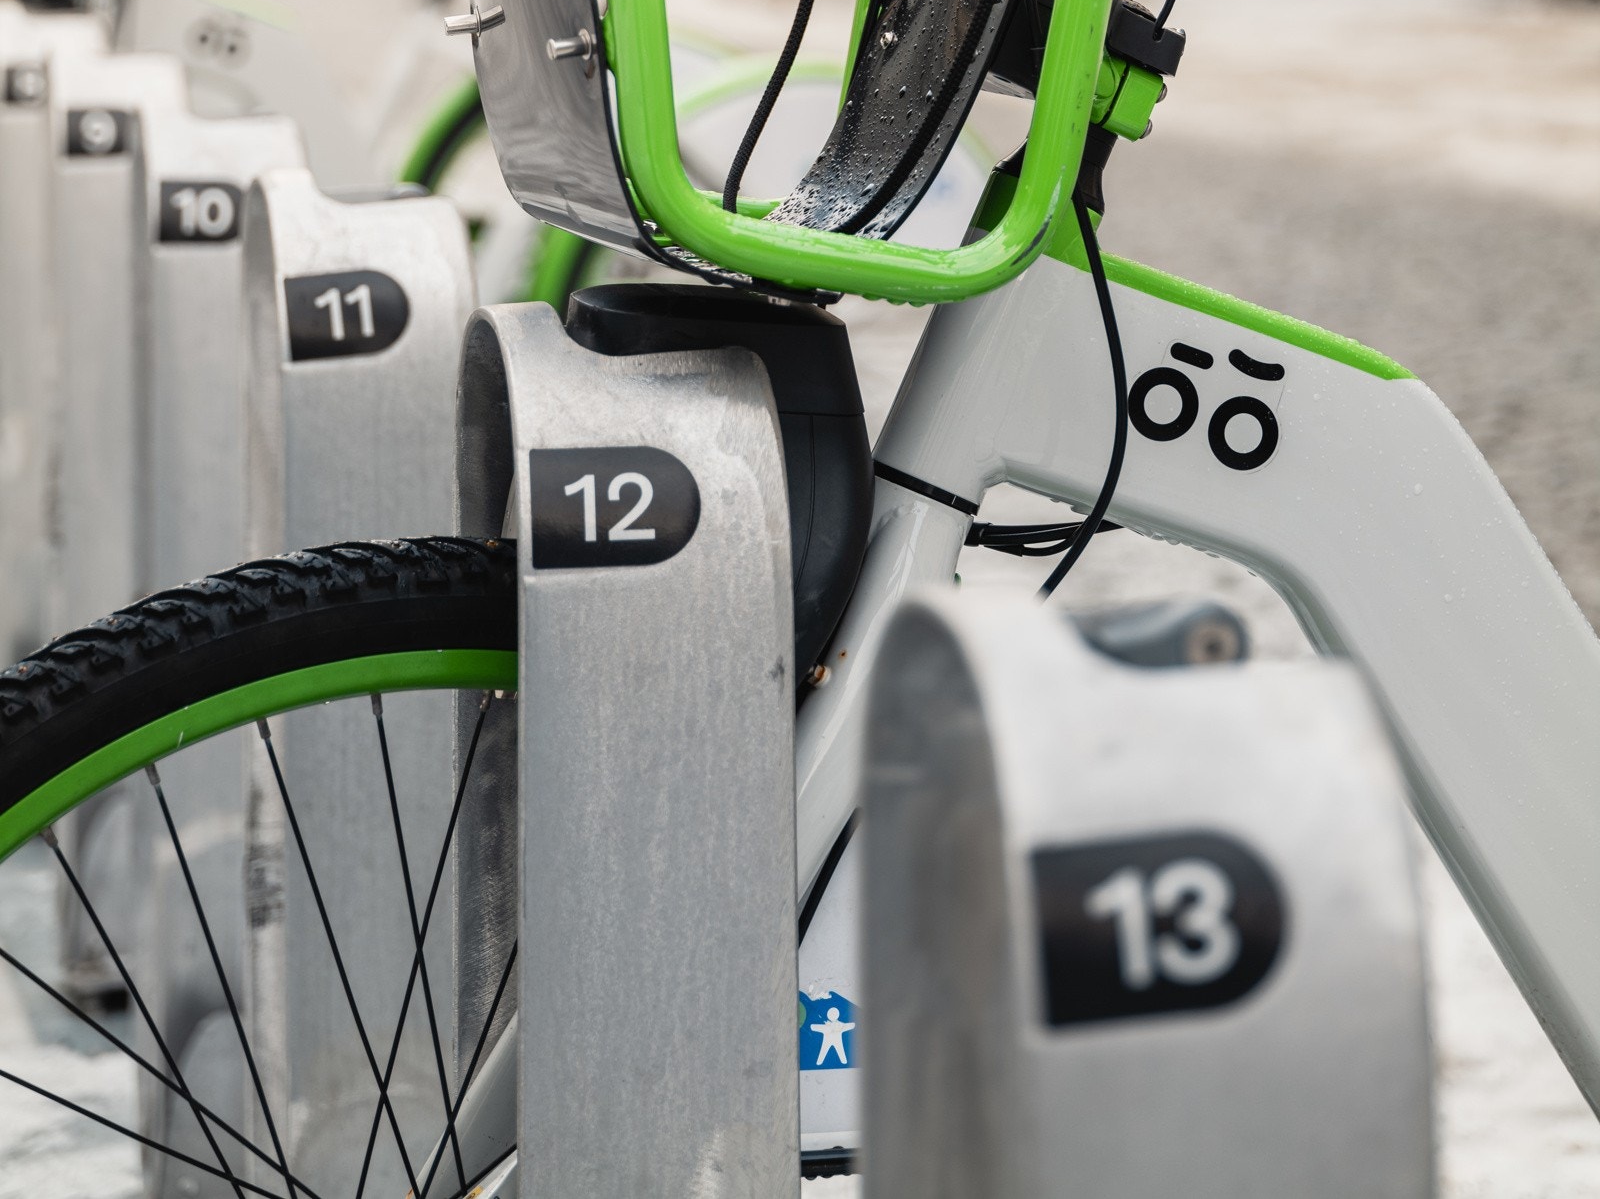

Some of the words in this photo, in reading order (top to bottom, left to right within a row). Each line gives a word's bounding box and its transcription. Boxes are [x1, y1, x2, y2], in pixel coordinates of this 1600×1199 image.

[170, 187, 235, 237] 10
[314, 284, 374, 341] 11
[564, 472, 655, 542] 12
[1083, 857, 1242, 989] 13
